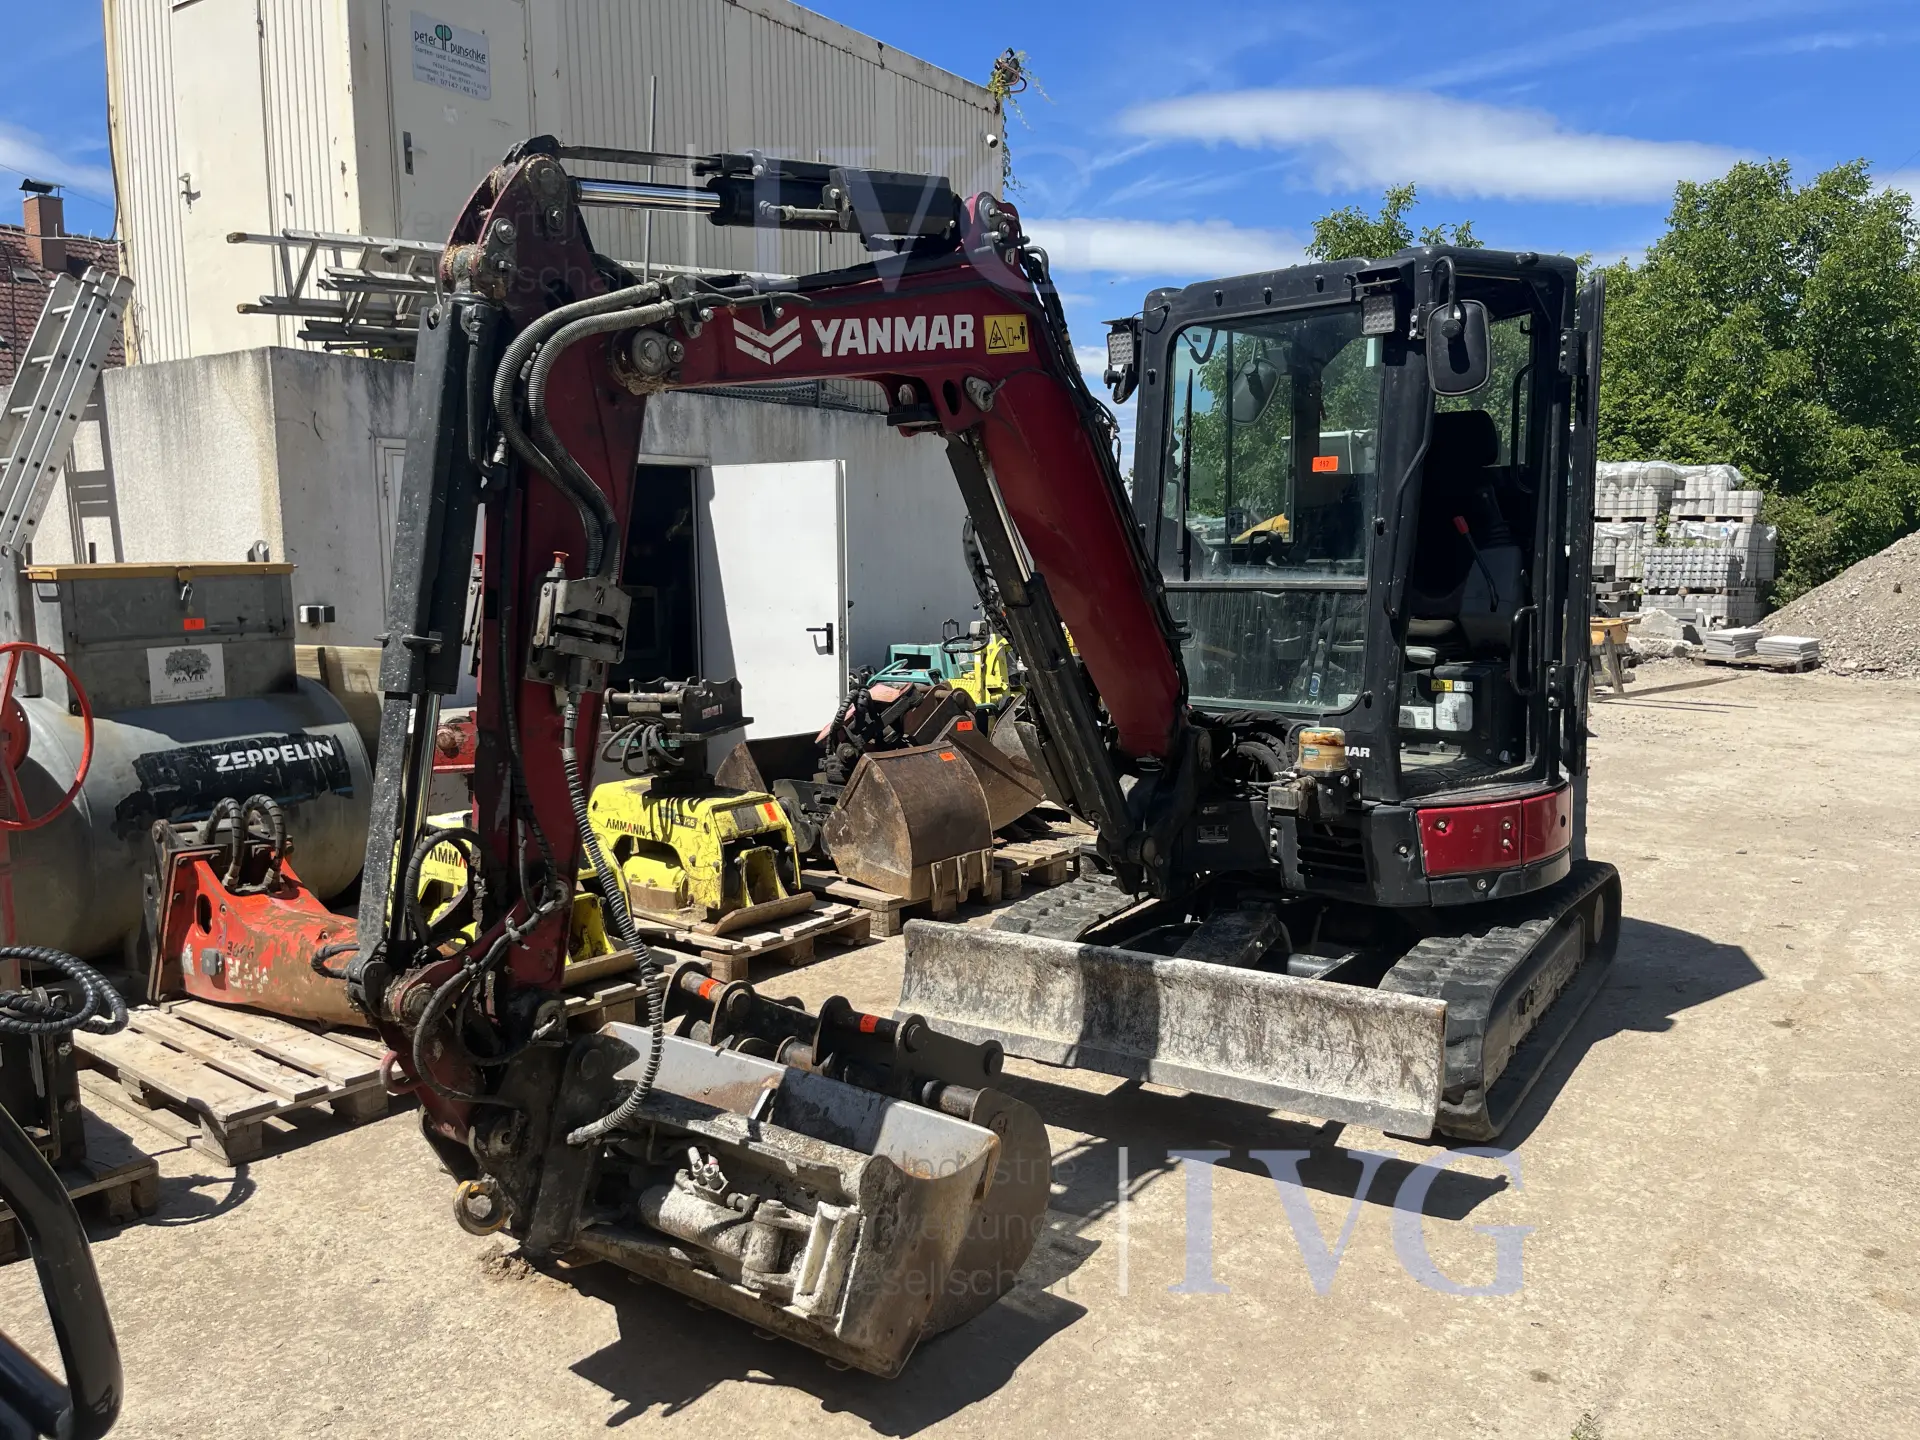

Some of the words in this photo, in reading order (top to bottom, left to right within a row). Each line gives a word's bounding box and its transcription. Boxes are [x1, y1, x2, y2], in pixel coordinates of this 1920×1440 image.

[414, 30, 437, 45] peter
[450, 43, 486, 62] punschke
[811, 314, 974, 357] YANMAR
[211, 740, 335, 773] ZEPPELIN
[606, 817, 646, 837] AMMANN
